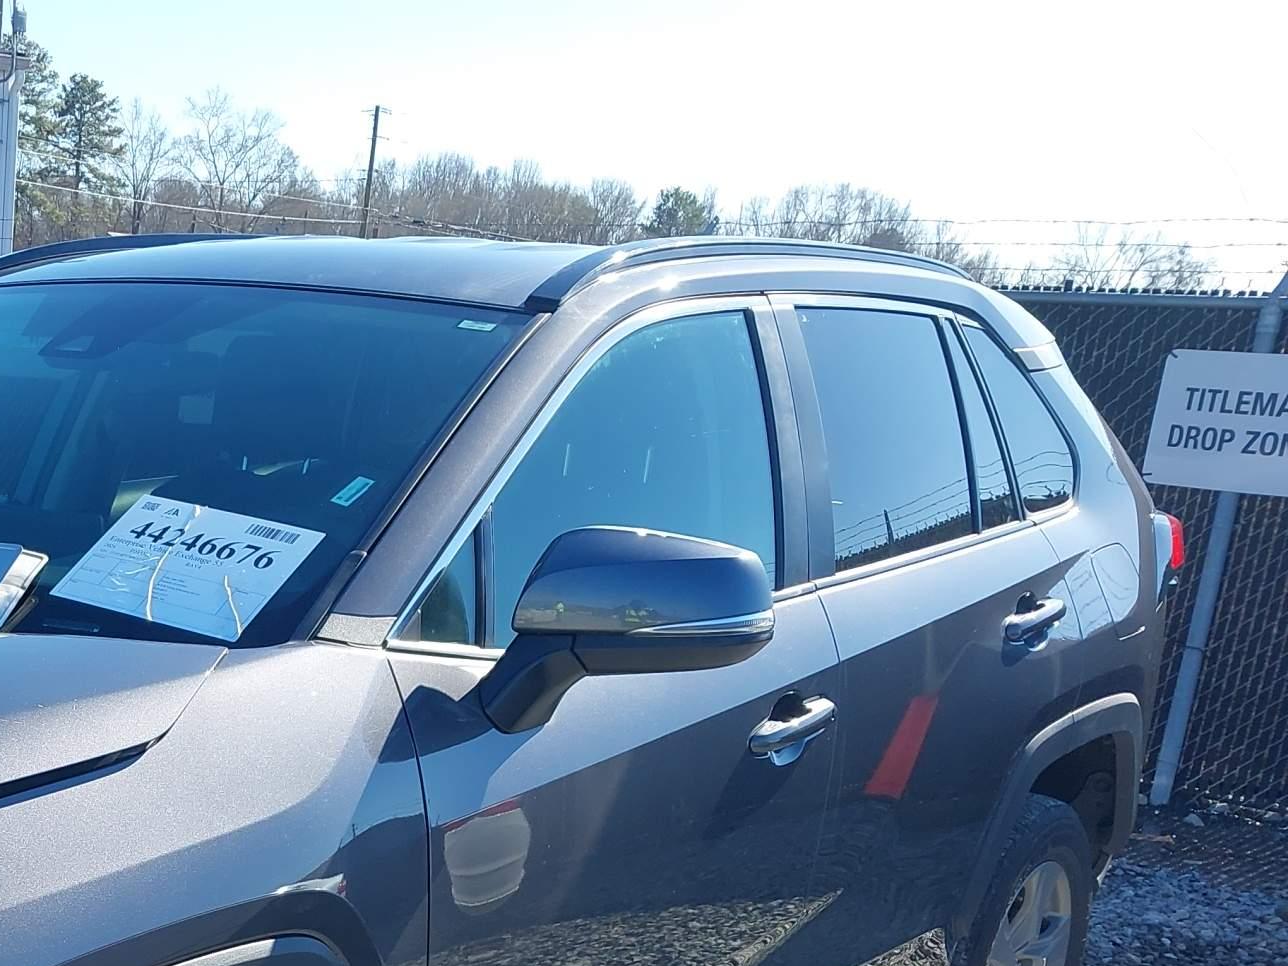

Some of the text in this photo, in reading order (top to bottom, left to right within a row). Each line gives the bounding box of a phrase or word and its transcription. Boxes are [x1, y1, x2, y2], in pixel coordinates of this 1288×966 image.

[1167, 424, 1235, 452] DROP
[129, 521, 282, 570] 44246676
[149, 543, 174, 555] Vehice
